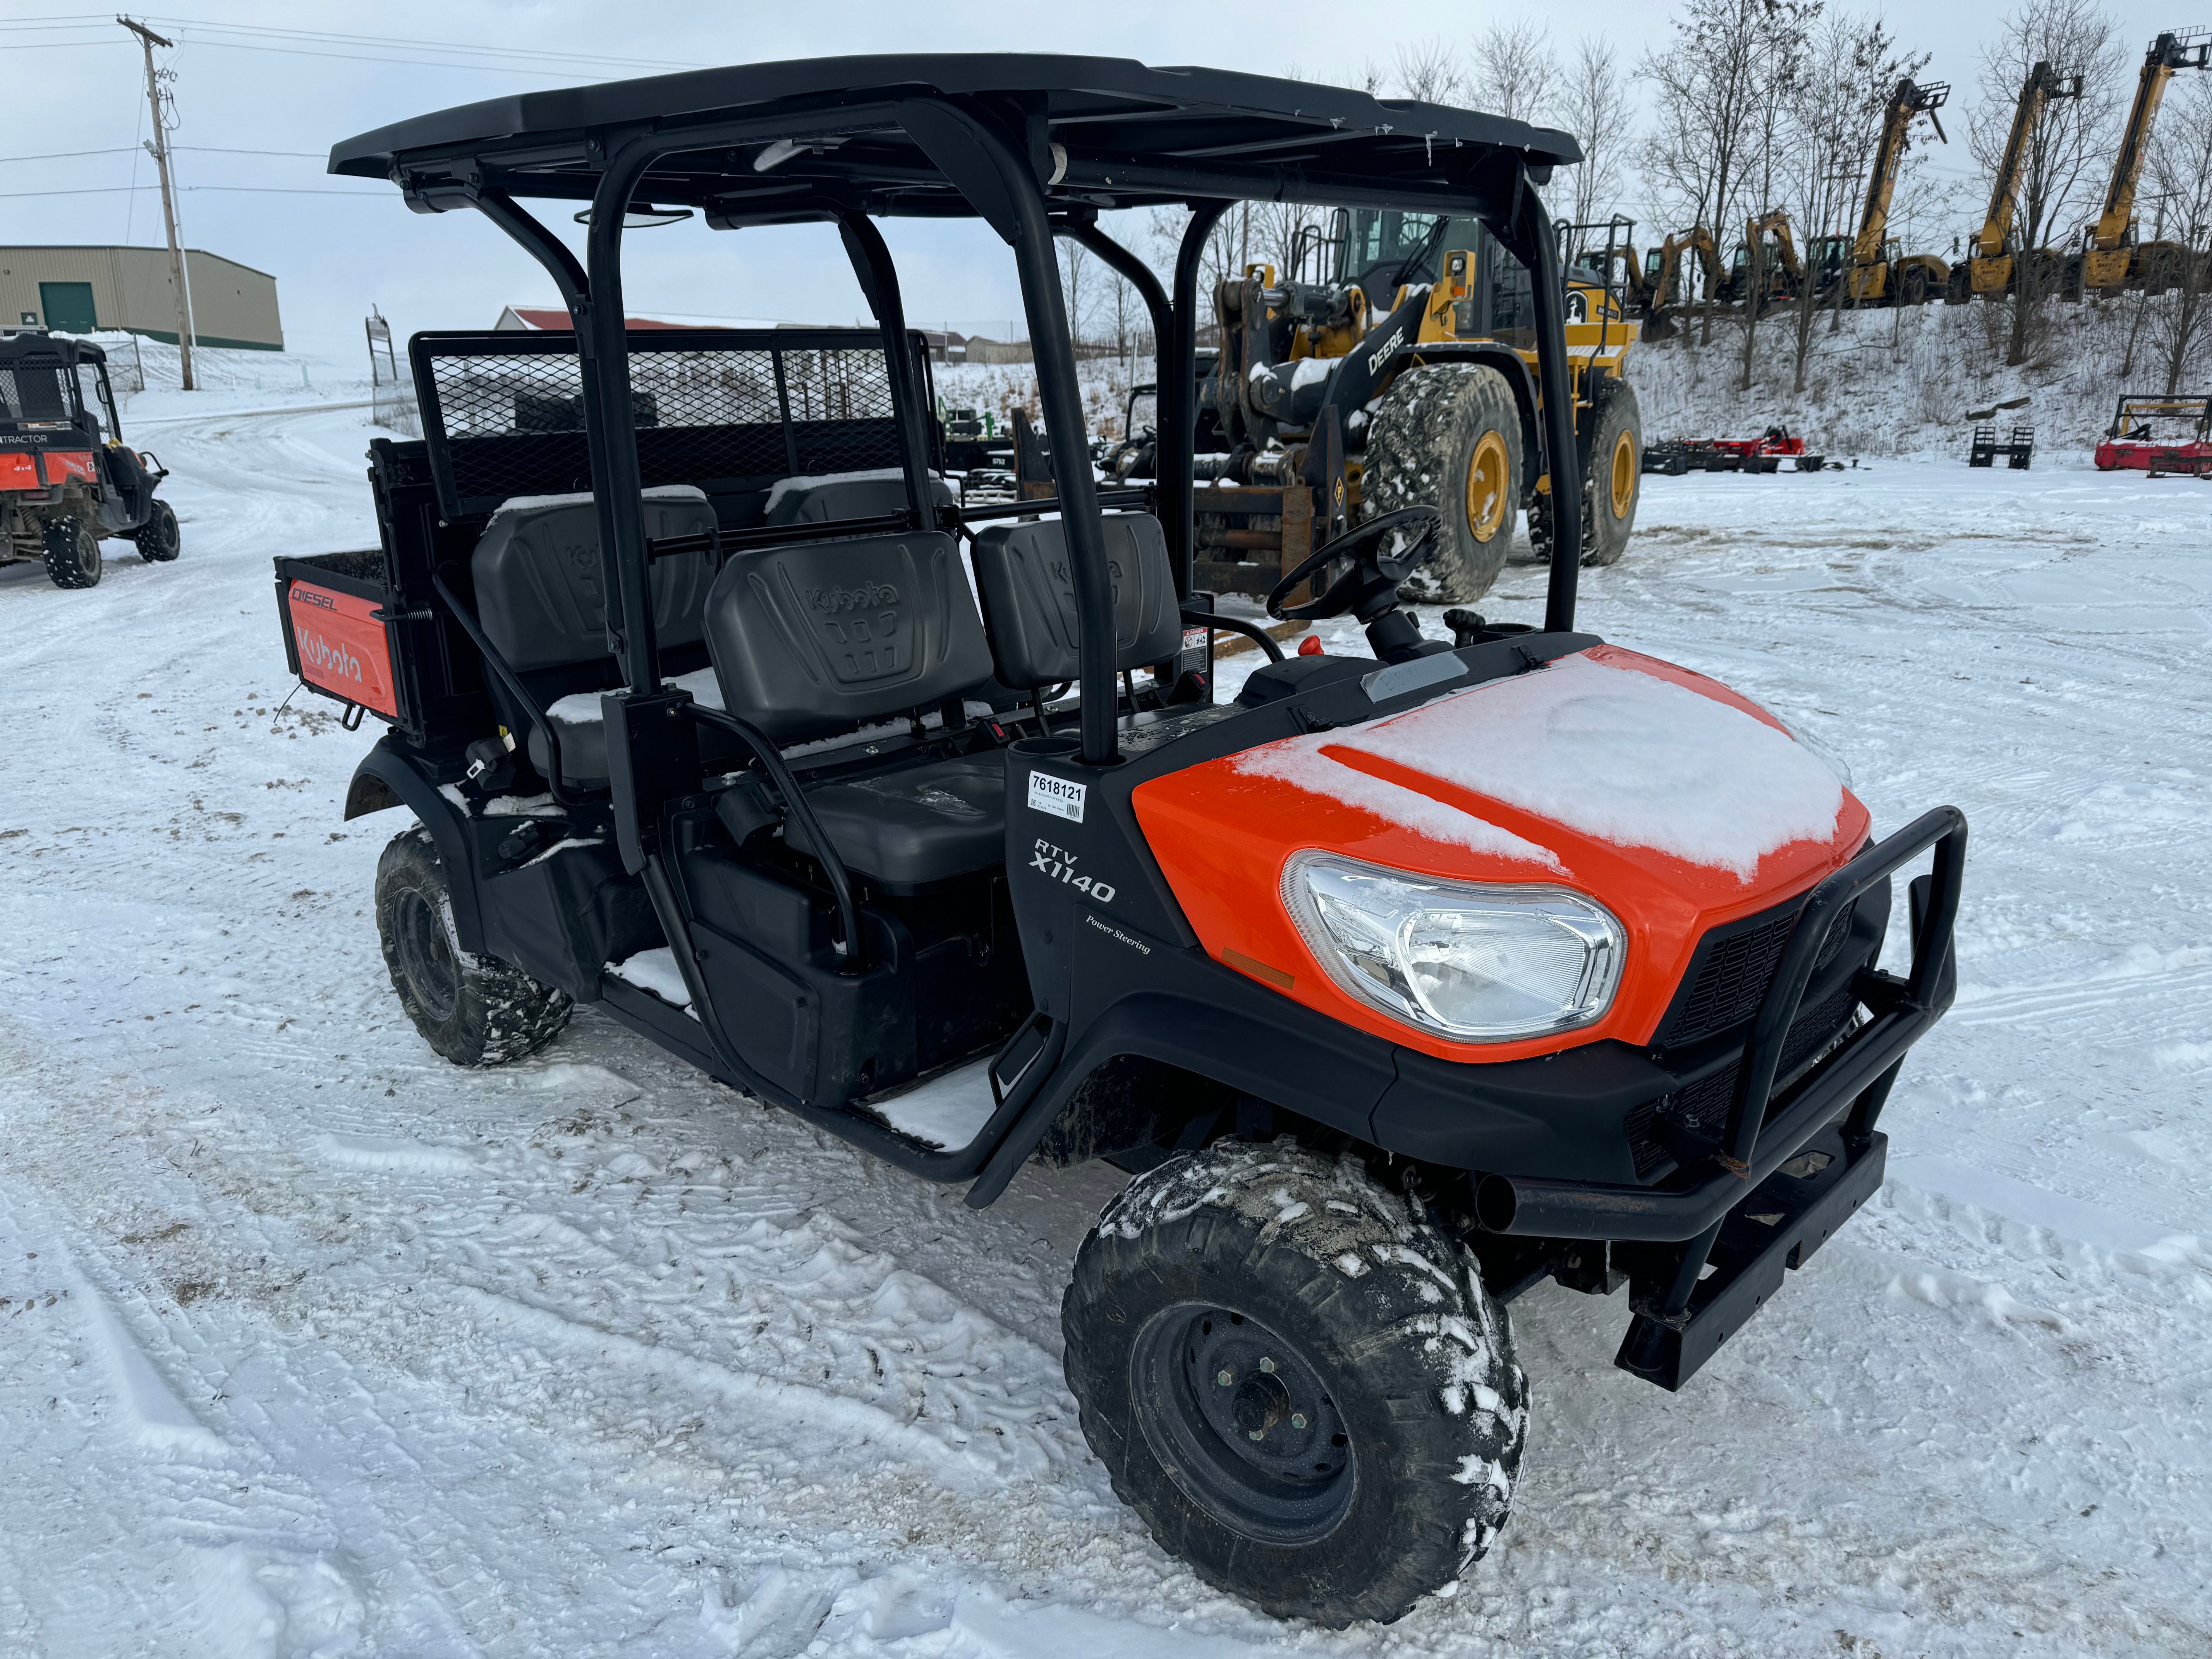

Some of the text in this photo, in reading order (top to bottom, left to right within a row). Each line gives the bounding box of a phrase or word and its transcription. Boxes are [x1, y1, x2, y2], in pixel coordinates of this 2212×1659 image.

[1368, 326, 1404, 377] DEERE
[292, 588, 338, 611] DIESEL
[804, 581, 899, 613] Kubota
[297, 625, 362, 683] Kubota
[1033, 775, 1081, 802] 7618121
[1035, 838, 1078, 865] RTV
[1028, 850, 1116, 902] X1140
[1085, 914, 1151, 955] Power Steering
